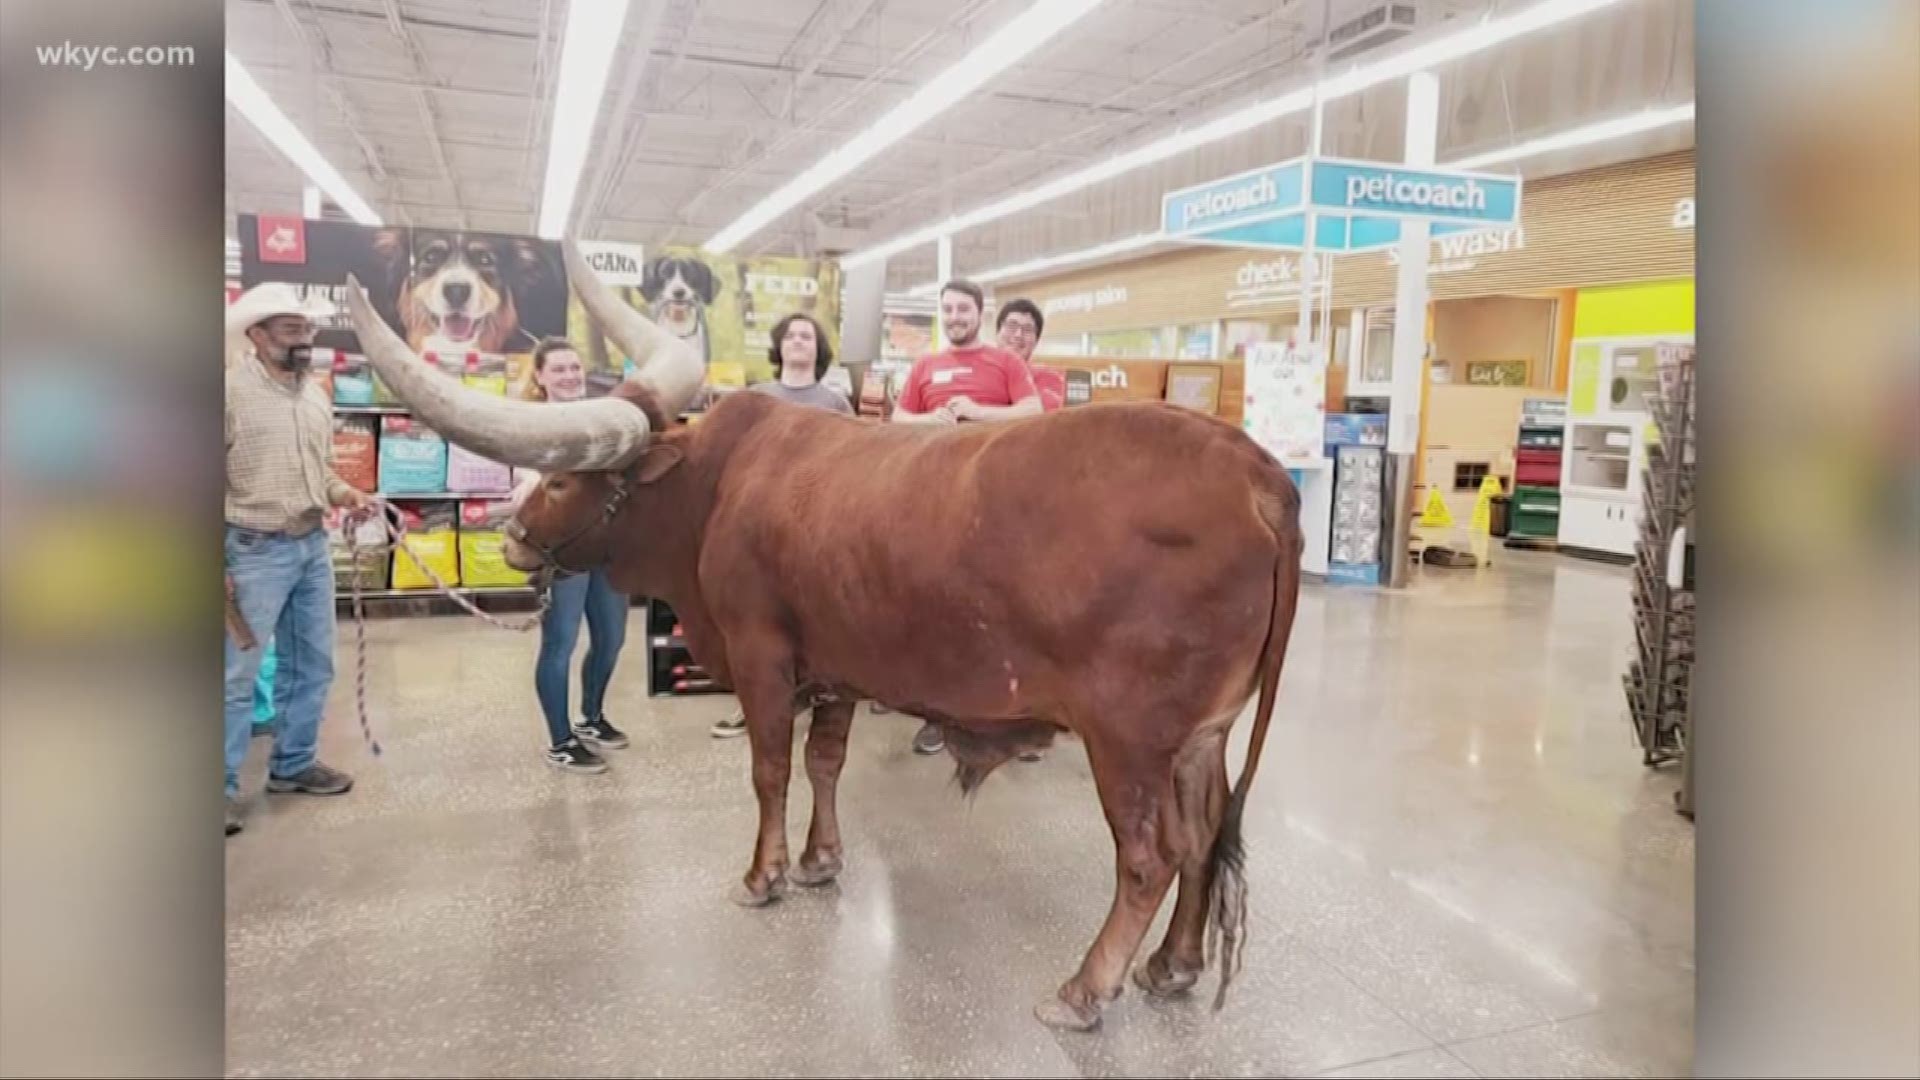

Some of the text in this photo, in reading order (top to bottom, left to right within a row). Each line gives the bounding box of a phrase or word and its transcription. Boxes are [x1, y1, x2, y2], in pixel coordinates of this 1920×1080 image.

[1182, 174, 1277, 230] petcoach
[1345, 172, 1486, 210] petcoach
[1440, 229, 1524, 259] wash
